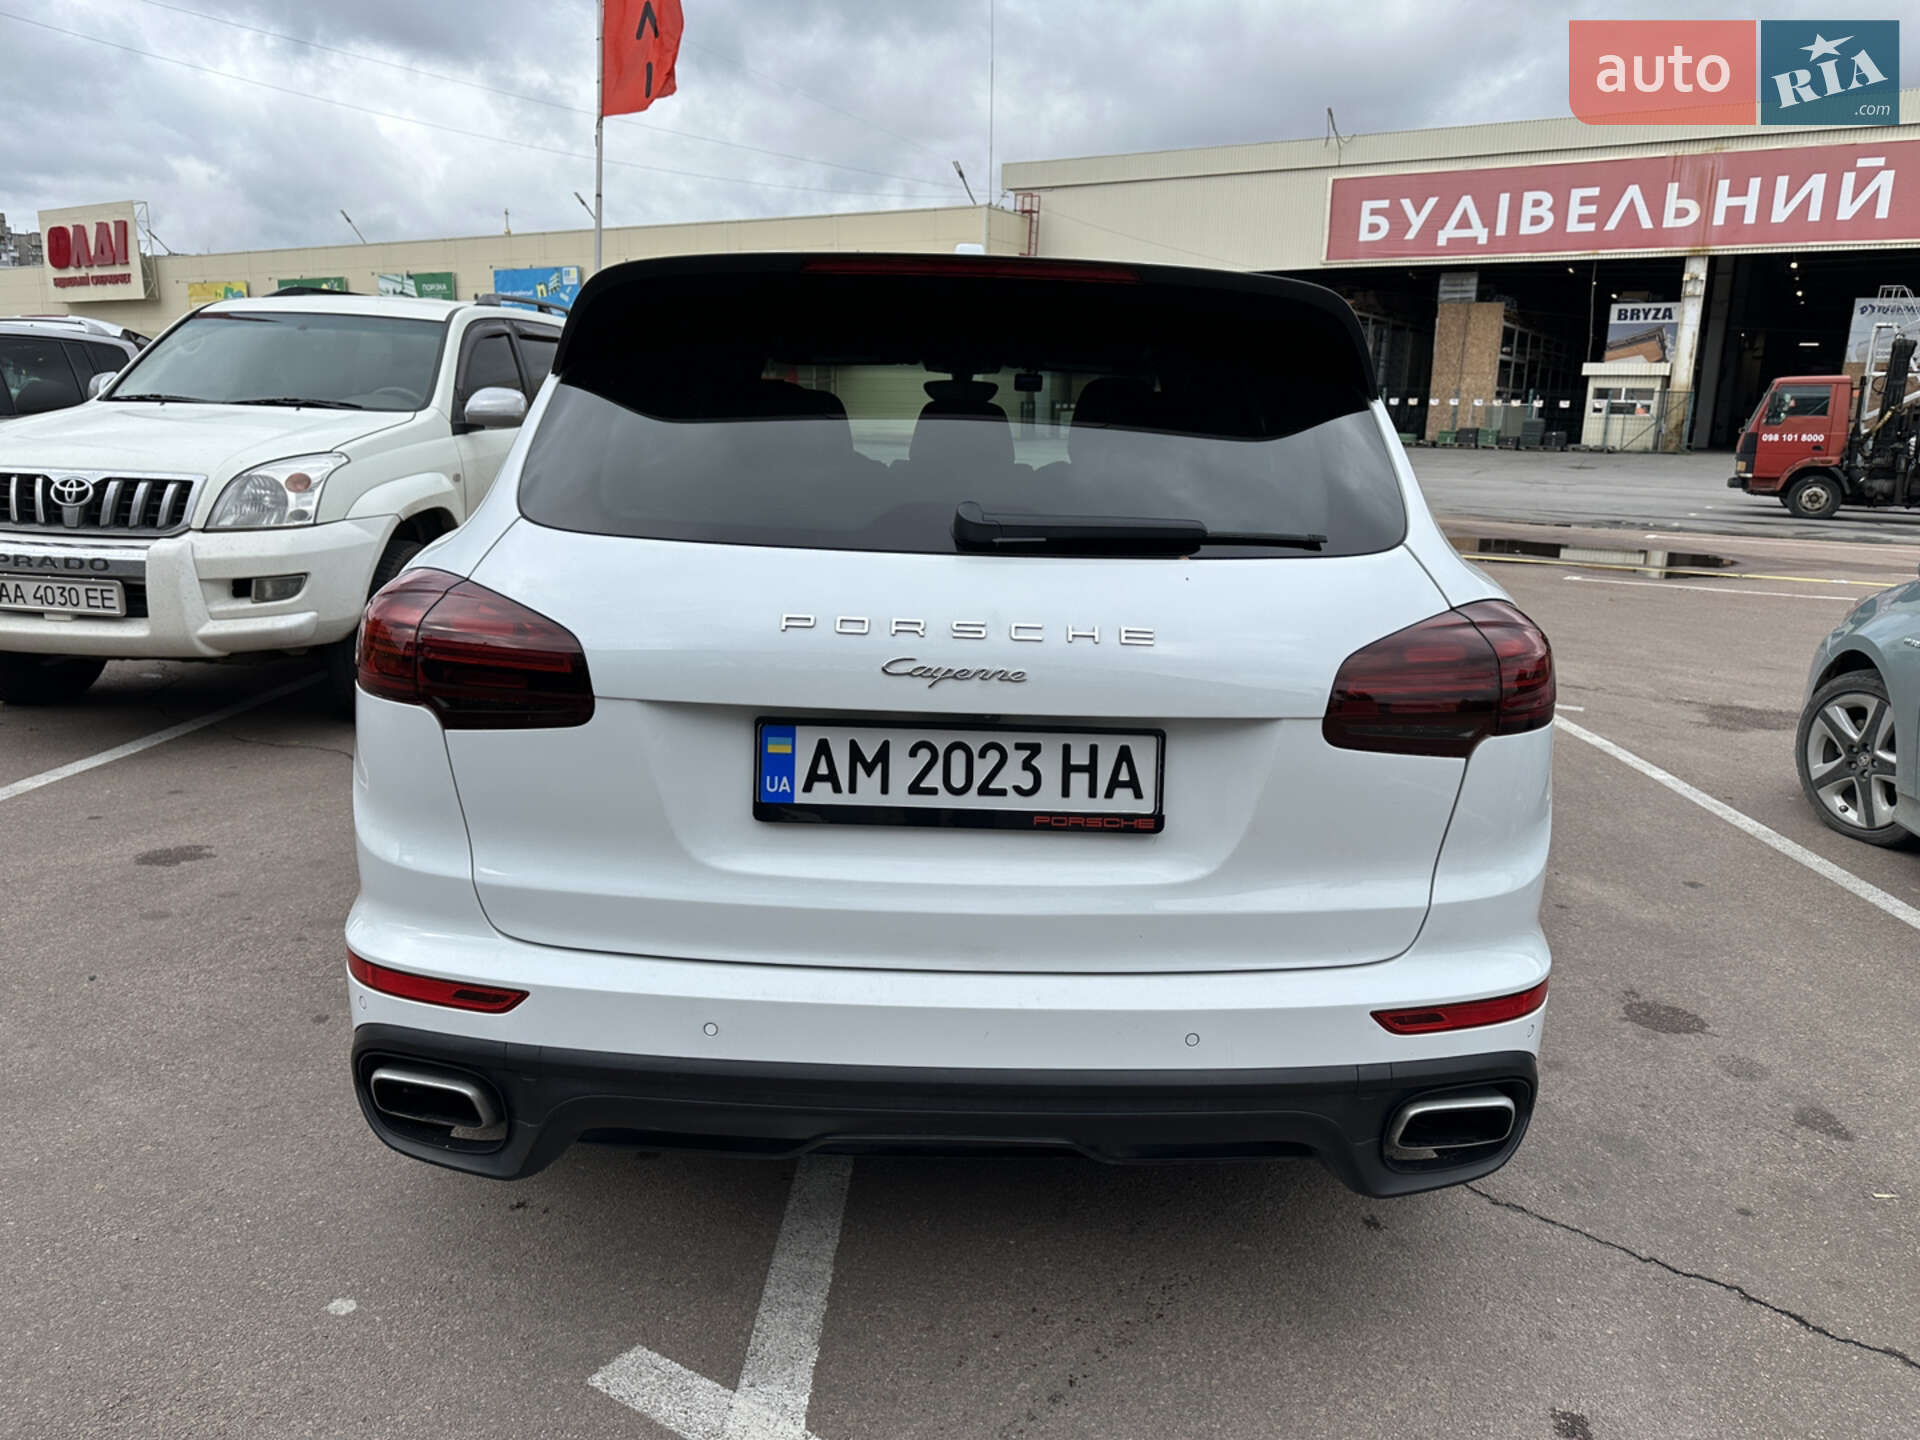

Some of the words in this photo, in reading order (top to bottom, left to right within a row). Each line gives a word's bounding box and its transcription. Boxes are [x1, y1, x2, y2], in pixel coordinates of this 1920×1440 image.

[1358, 156, 1896, 247] БУДІВЕЛЬНИЙ
[1617, 307, 1673, 321] BRYZA
[1782, 433, 1799, 442] 101
[1800, 433, 1825, 442] 8000
[0, 553, 110, 571] PRADO
[0, 582, 26, 605] AA
[32, 584, 80, 608] 4030
[85, 587, 117, 610] EE
[780, 613, 1155, 647] PORSCHE
[881, 656, 1028, 689] Cayenne
[802, 738, 890, 795] AM
[907, 740, 1042, 798] 2023
[1061, 743, 1144, 800] HA
[766, 776, 791, 793] UA
[1033, 815, 1156, 830] PORSCHE
